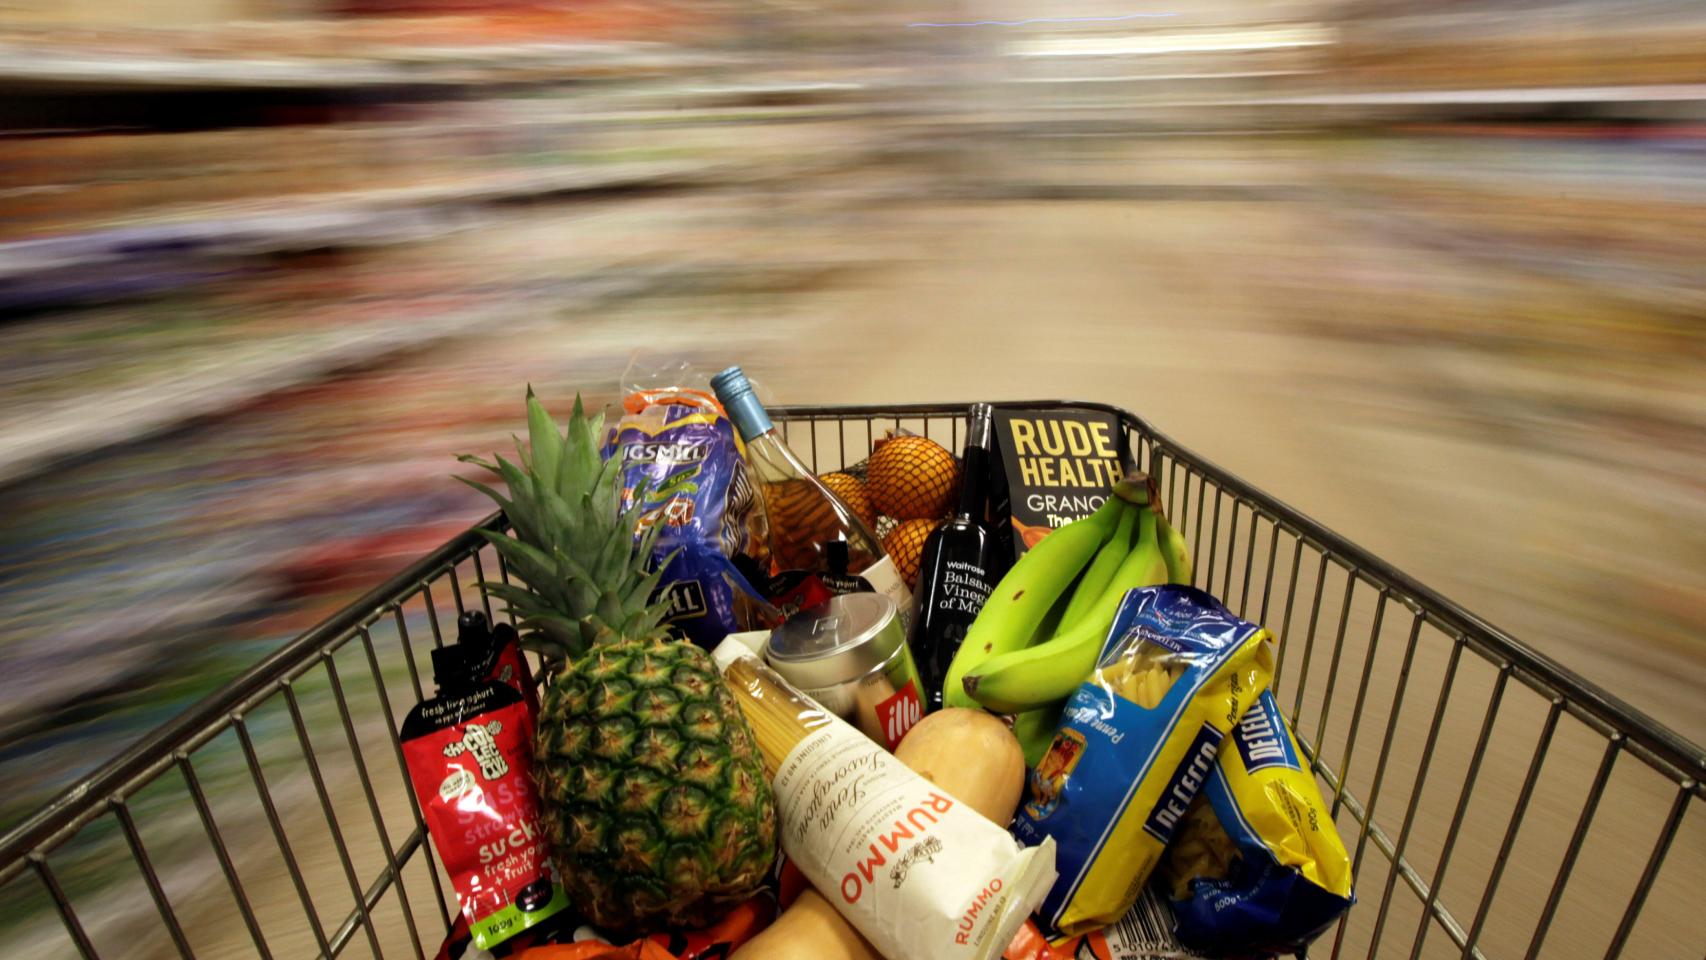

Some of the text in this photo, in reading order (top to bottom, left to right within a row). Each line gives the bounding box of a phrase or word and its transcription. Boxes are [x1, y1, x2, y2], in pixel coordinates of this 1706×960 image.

[1009, 418, 1117, 457] RUDE
[1019, 457, 1125, 488] HEALTH
[1027, 494, 1109, 512] GRANO
[944, 571, 994, 594] Balsam
[946, 561, 985, 576] Waitrose
[940, 597, 981, 615] of Mo
[943, 584, 988, 607] Vineg
[888, 696, 921, 742] illy
[1240, 699, 1284, 761] DE CECC
[797, 733, 832, 762] LINGUINE
[1155, 742, 1217, 830] DE CECCO
[841, 791, 954, 904] RUMMO
[484, 852, 519, 878] fresh
[505, 859, 533, 881] fruit
[955, 879, 1003, 945] RUMMO
